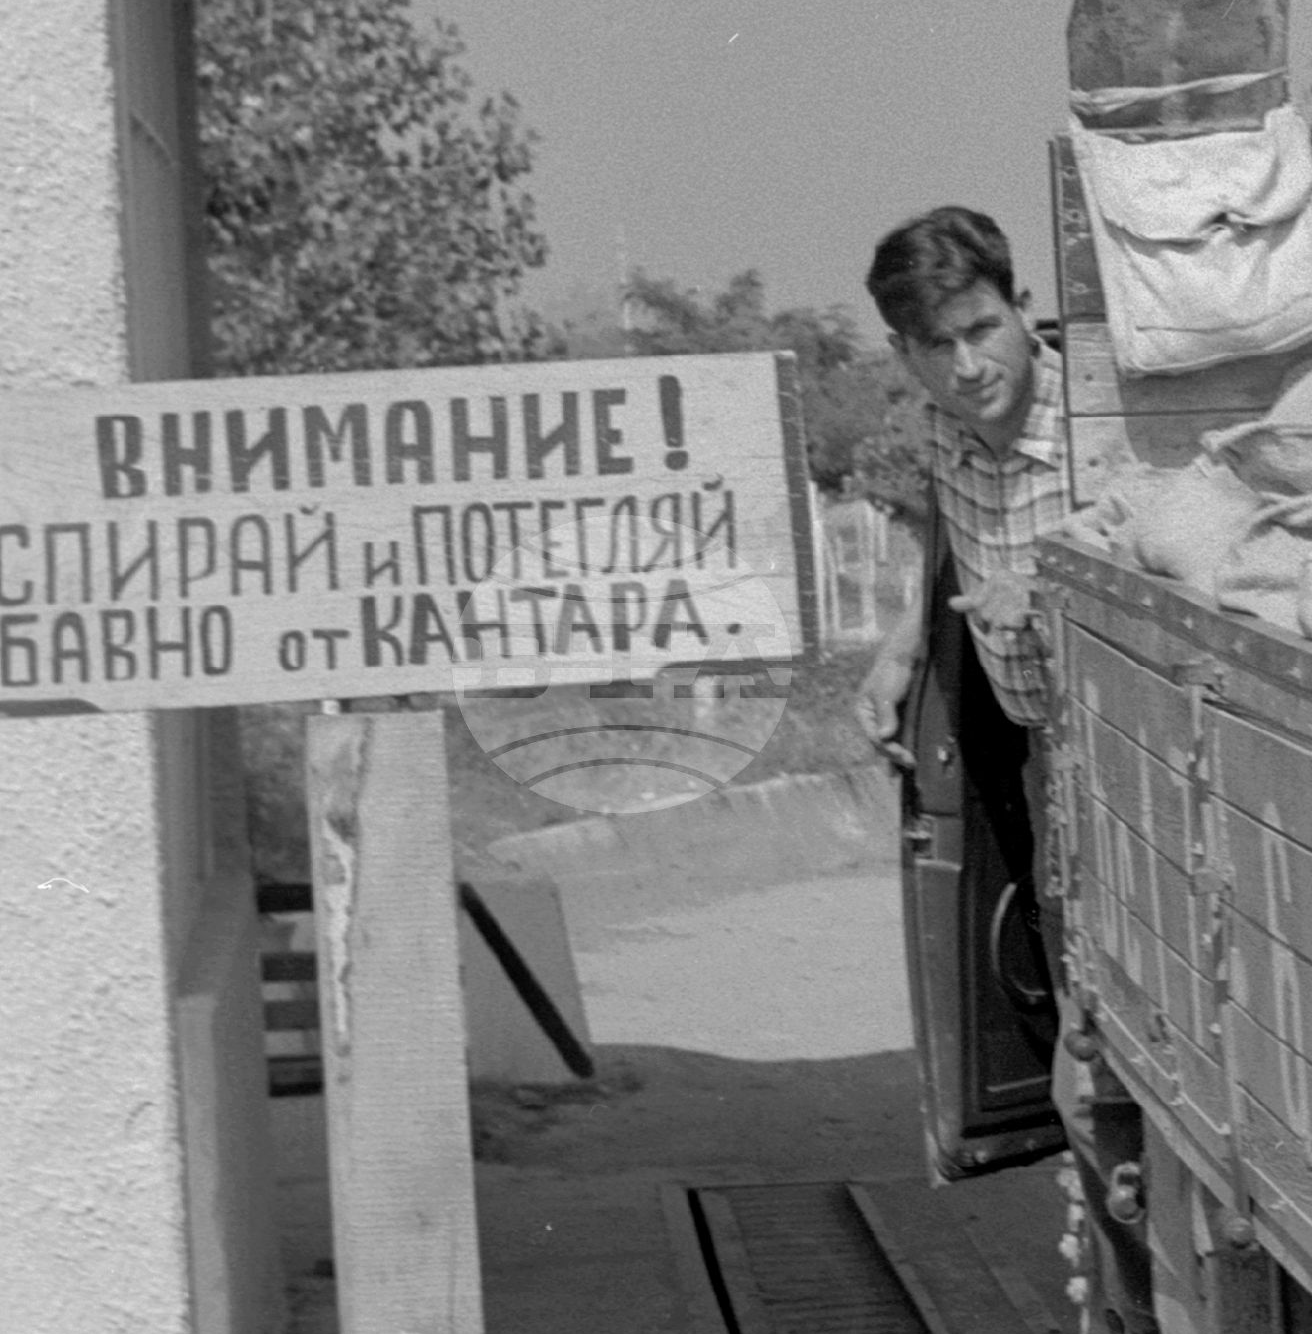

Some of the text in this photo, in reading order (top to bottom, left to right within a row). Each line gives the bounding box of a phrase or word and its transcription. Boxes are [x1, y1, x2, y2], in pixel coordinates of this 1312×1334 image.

[95, 374, 689, 499] ВНИМАНИЕ!
[0, 506, 340, 607] СПИРАЙ
[412, 476, 737, 588] ПОТЕГЛЯЙ
[0, 605, 234, 688] БАВНО
[360, 579, 744, 667] КАНТАРА.
